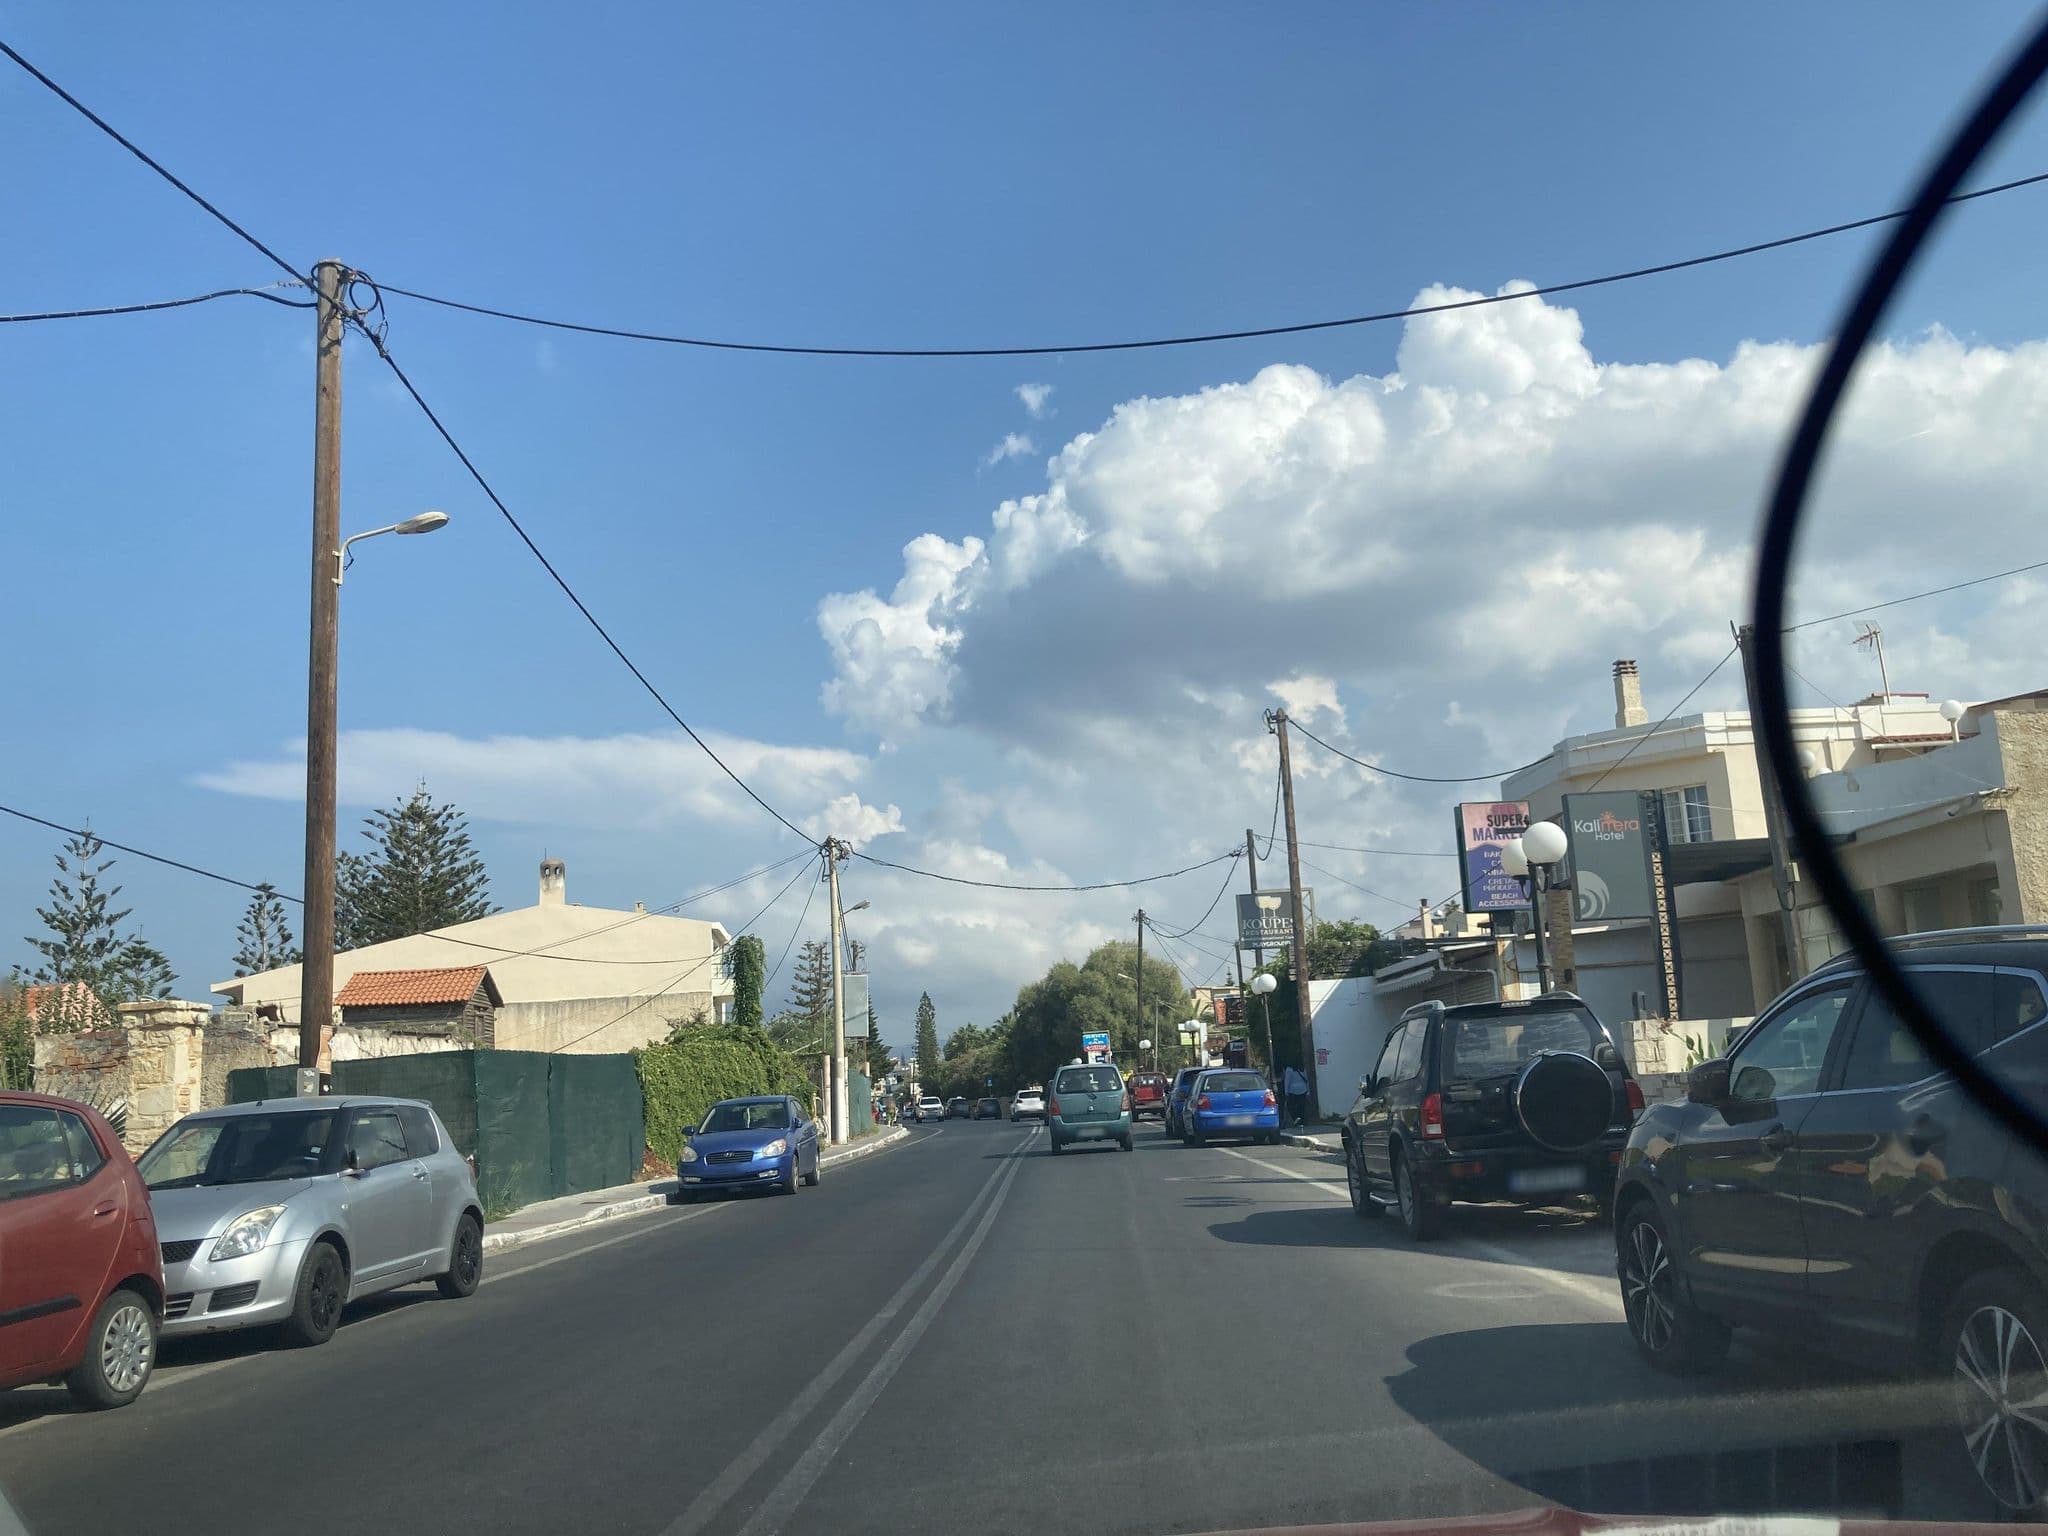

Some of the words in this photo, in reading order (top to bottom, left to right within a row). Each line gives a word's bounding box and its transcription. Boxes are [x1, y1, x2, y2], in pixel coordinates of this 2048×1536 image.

[1487, 815, 1523, 827] SUPER
[1574, 819, 1640, 832] Kalimera
[1595, 831, 1625, 841] Hotel
